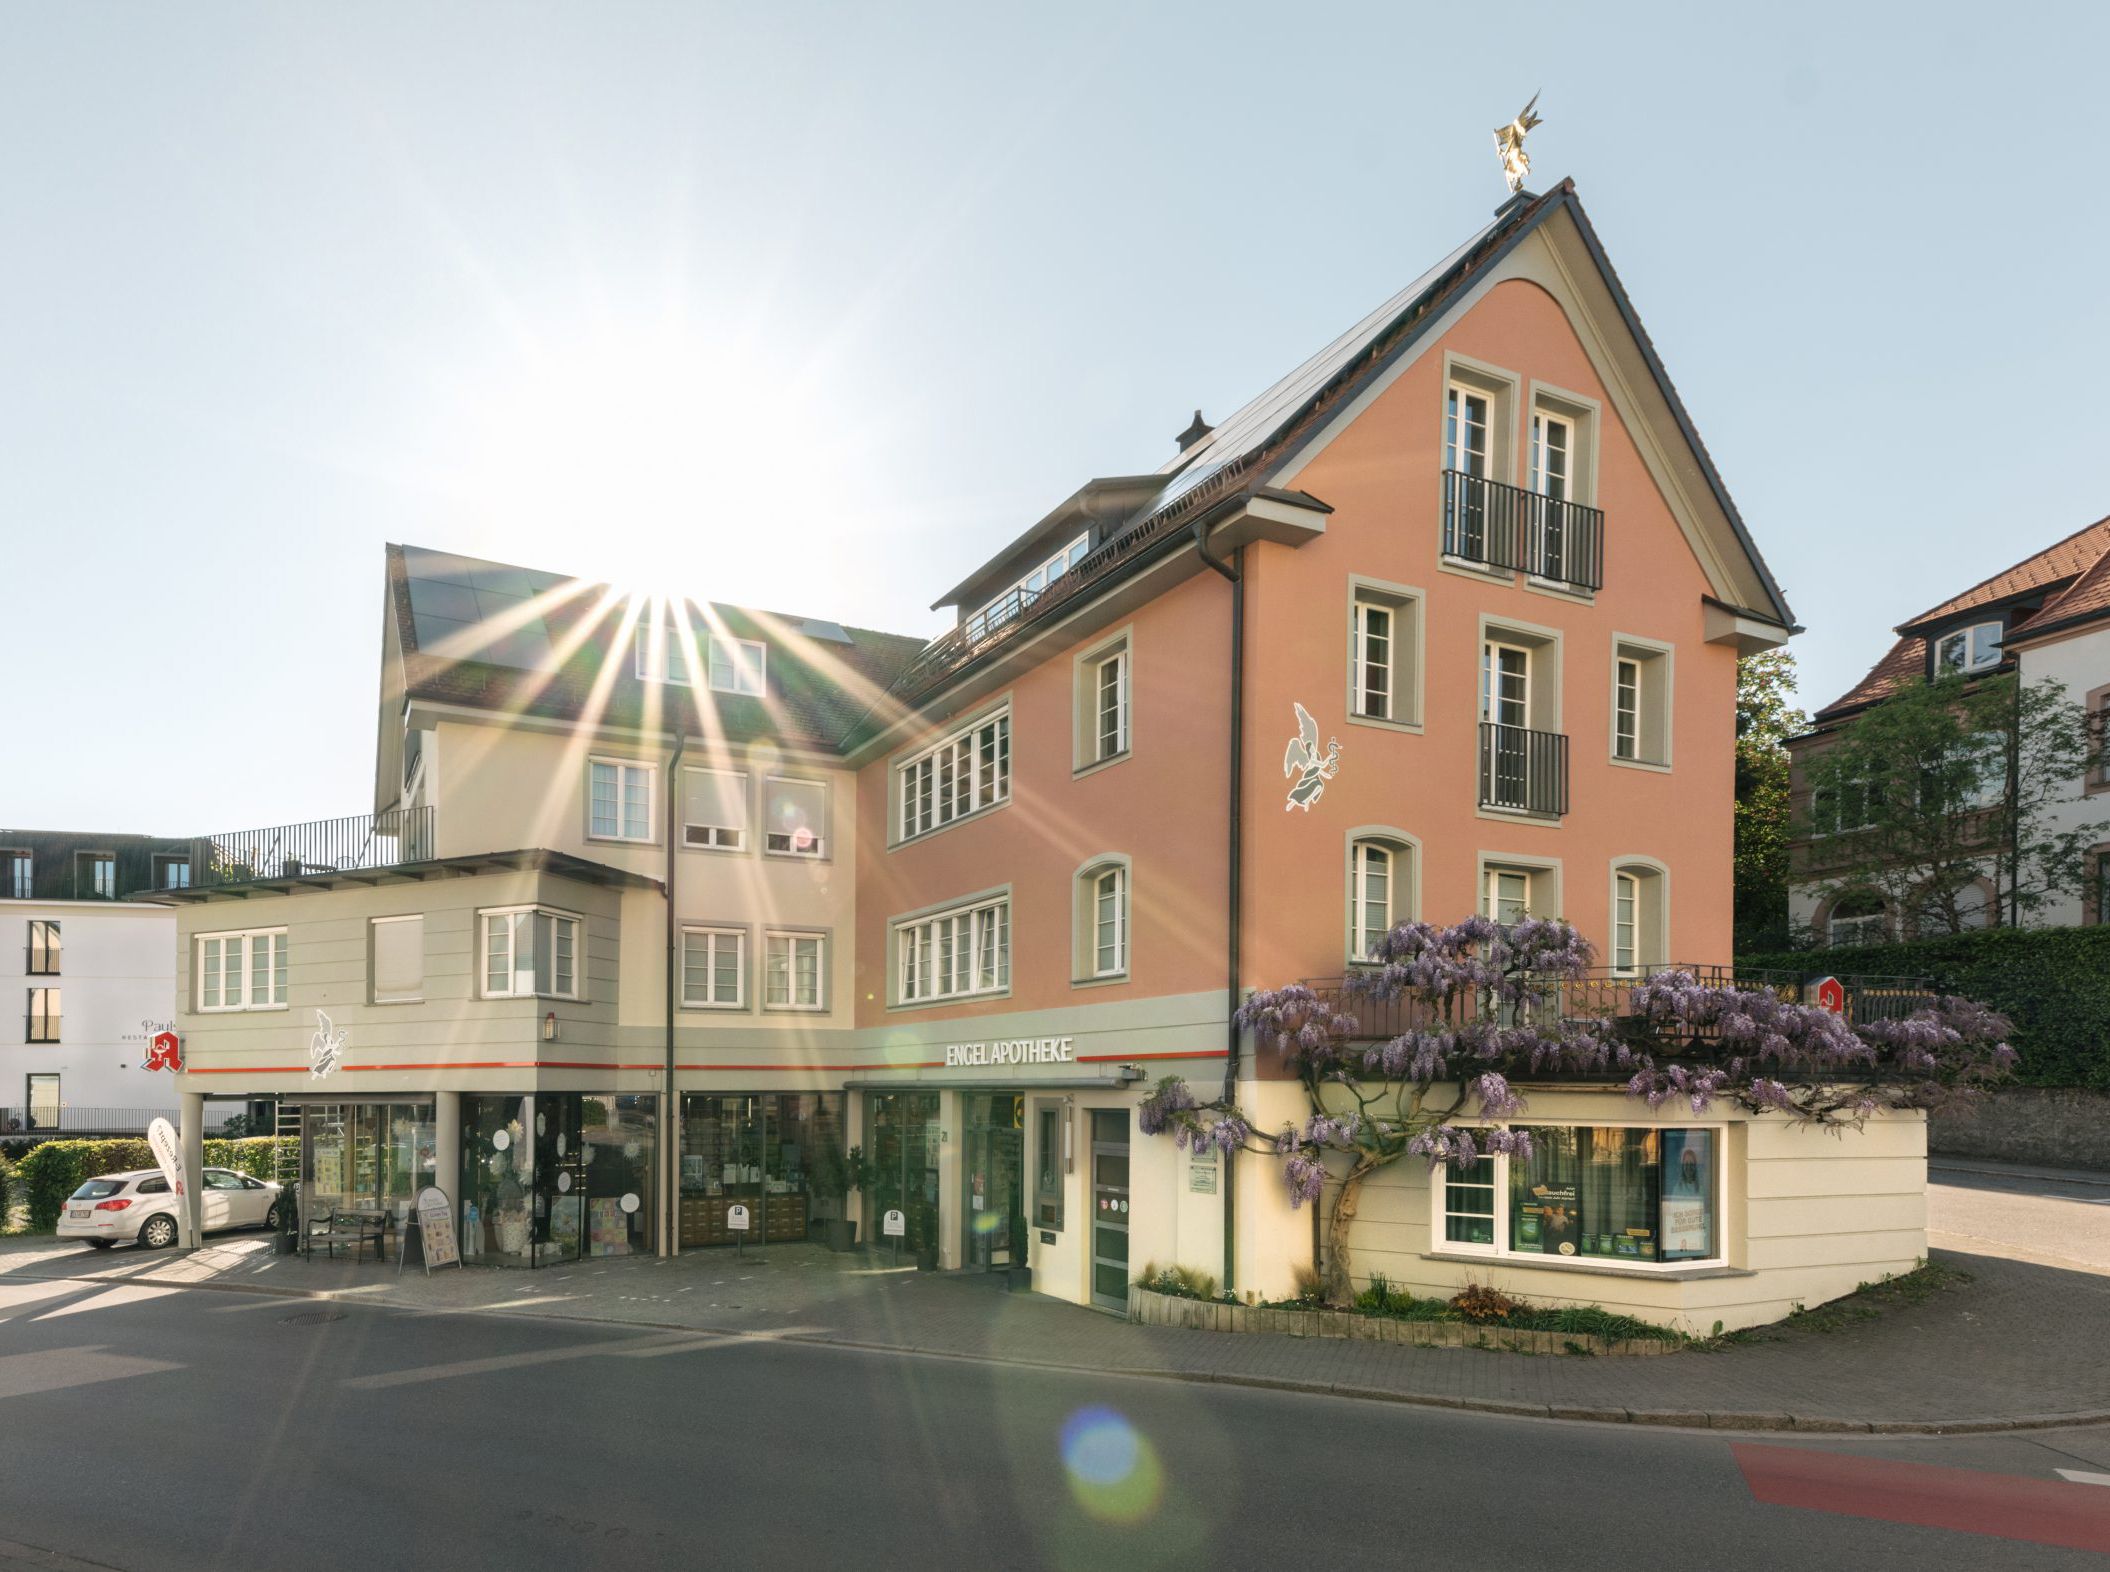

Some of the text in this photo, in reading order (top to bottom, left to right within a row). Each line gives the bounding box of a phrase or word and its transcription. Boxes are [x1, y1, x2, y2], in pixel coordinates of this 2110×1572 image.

[946, 1038, 1072, 1066] ENGEL APOTHEKE
[941, 1131, 948, 1142] 21
